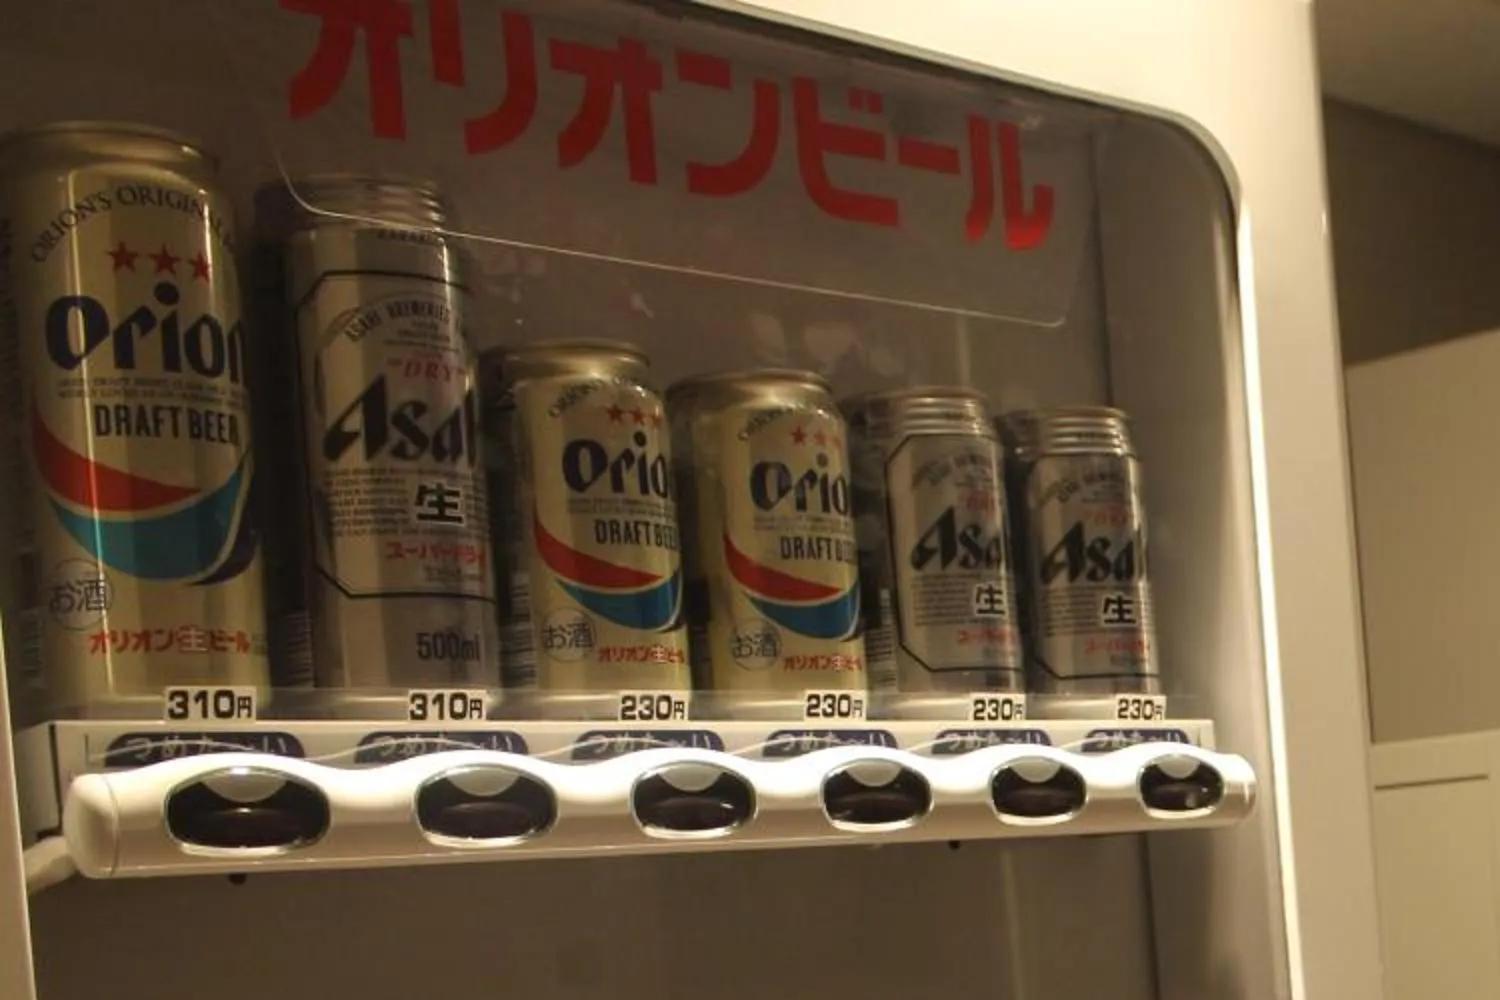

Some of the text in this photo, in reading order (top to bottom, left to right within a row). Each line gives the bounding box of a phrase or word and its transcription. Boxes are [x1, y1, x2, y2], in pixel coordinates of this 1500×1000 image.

[279, 0, 1054, 251] オリオンビール
[95, 403, 184, 438] DRAFT
[415, 482, 464, 523] 生
[595, 518, 650, 546] DRAFT
[780, 535, 832, 561] DRAFT
[51, 579, 108, 612] お酒
[975, 584, 1006, 615] 生
[1103, 595, 1137, 625] 生
[89, 625, 252, 655] オリオン生ビール
[416, 631, 481, 661] 500ml
[542, 622, 594, 650] お酒
[731, 631, 780, 659] お酒
[168, 689, 252, 719] 310円
[409, 692, 483, 720] 310円
[620, 694, 685, 720] 230円
[806, 693, 863, 718] 230円
[973, 698, 1023, 720] 230円
[1117, 698, 1163, 720] 230円
